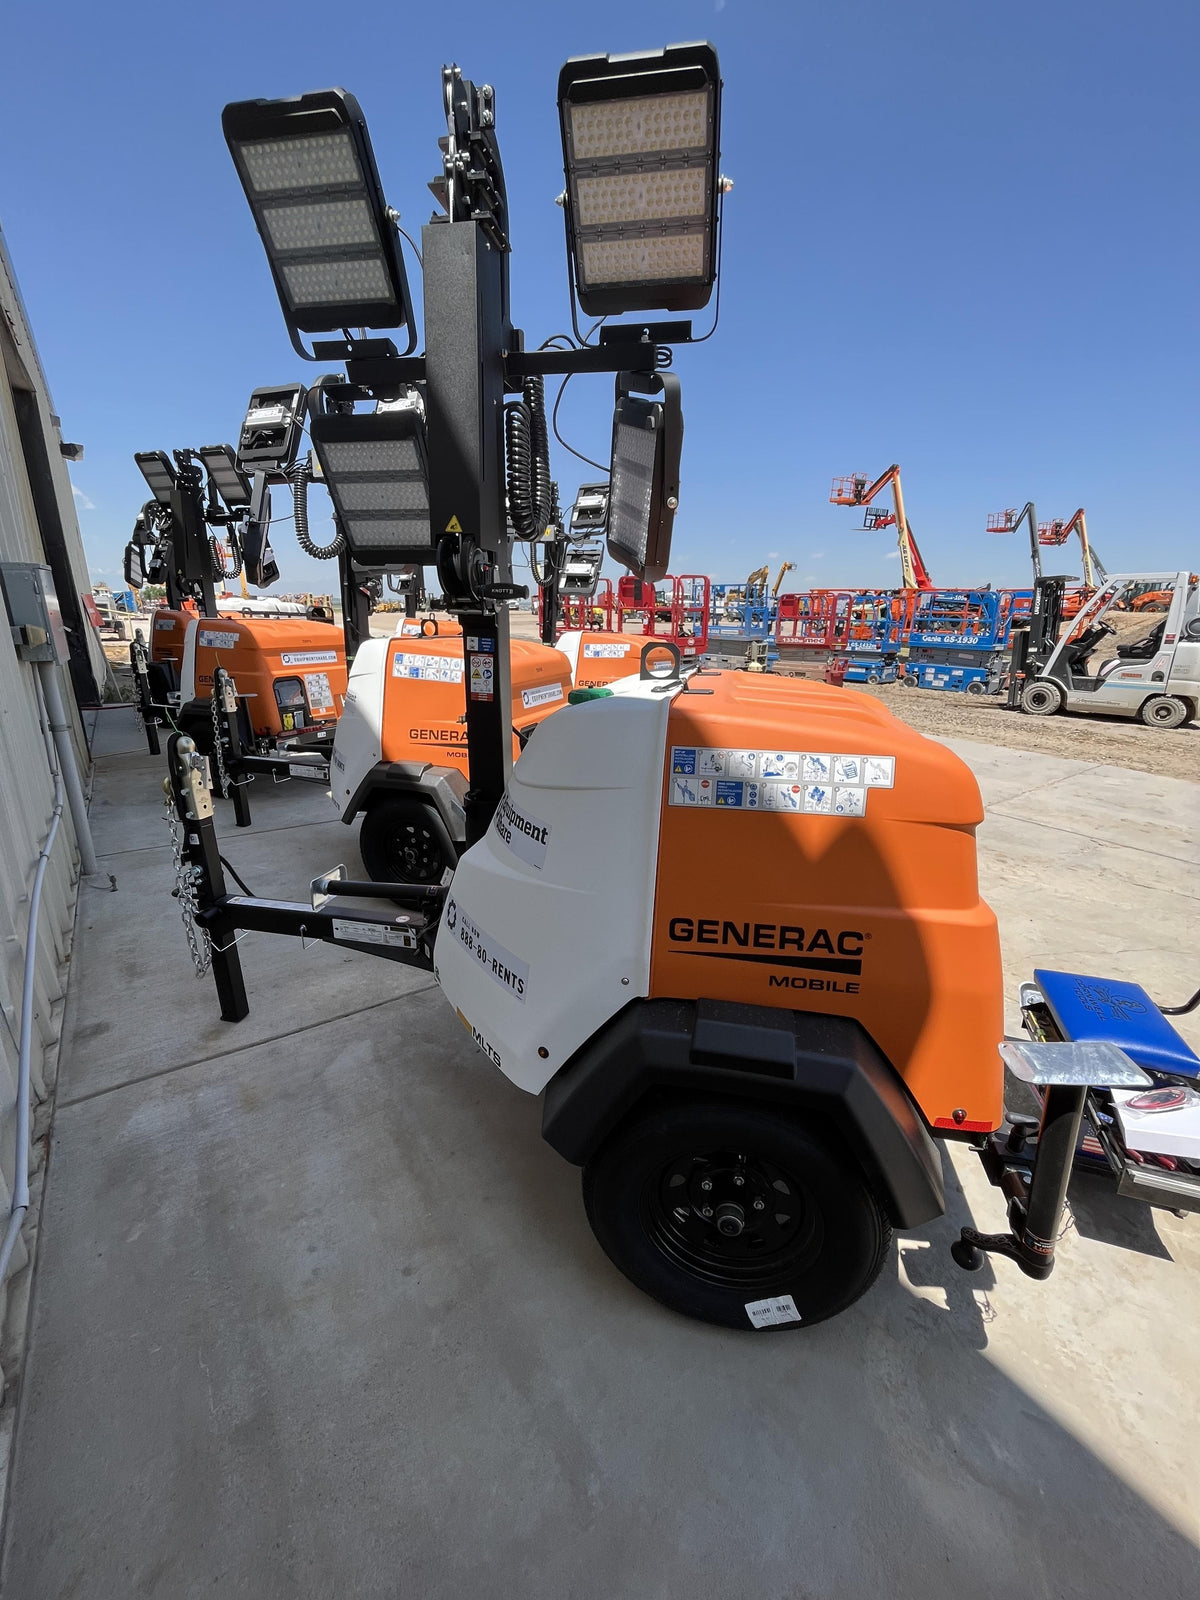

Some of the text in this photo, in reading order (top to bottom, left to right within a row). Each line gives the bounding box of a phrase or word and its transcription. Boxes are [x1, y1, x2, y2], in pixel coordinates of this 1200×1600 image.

[943, 636, 979, 645] GS-1930
[578, 680, 611, 688] GENER
[409, 728, 468, 742] GENERA
[461, 926, 524, 994] 888-80-RENTS
[769, 975, 860, 994] MOBILE
[472, 1026, 501, 1067] MLTS
